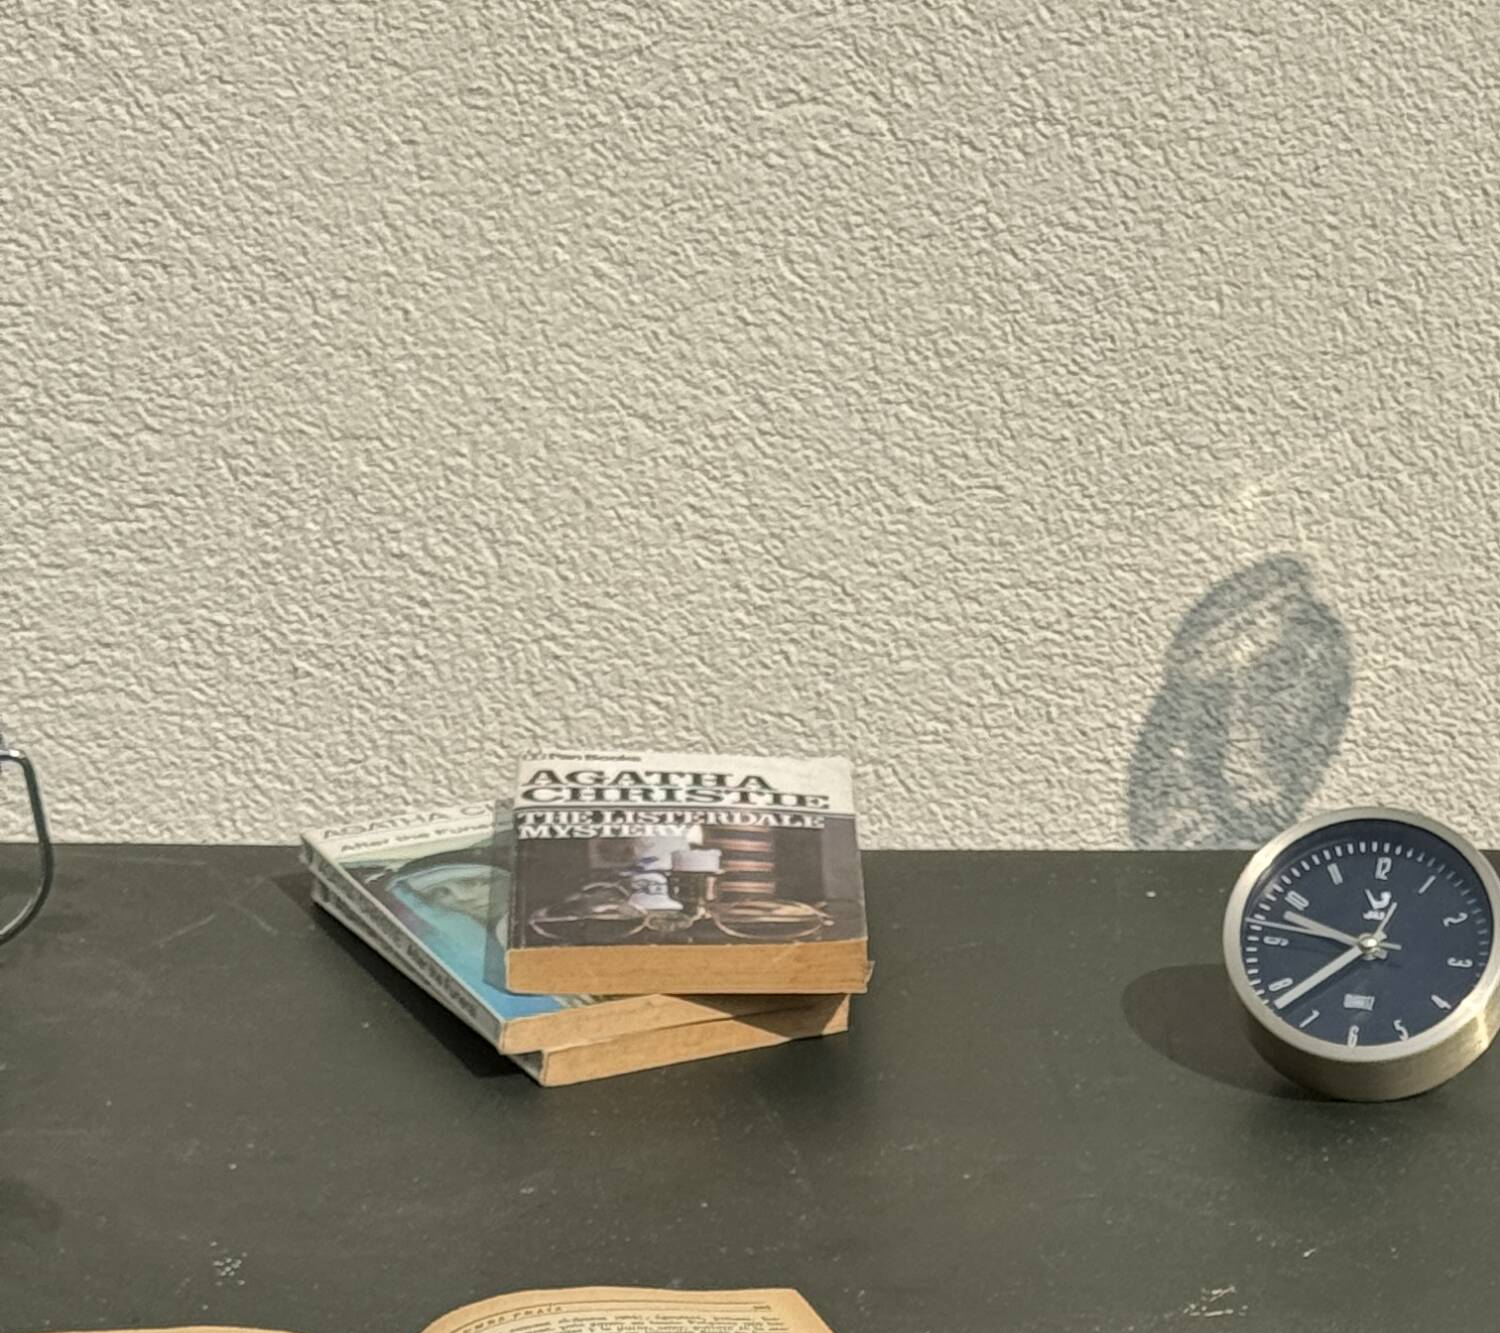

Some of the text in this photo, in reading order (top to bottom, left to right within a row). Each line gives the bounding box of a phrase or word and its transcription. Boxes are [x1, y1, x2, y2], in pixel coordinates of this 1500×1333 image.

[520, 769, 778, 791] AGATHA
[520, 786, 830, 810] CHRISTIE
[518, 810, 825, 828] THE LISTERDALE
[518, 823, 690, 840] MYSTERY
[1375, 857, 1392, 880] 12
[1418, 875, 1436, 894] 1
[1284, 890, 1310, 911] 10
[1443, 912, 1468, 927] 2
[1447, 957, 1473, 969] 3
[1268, 977, 1293, 992] 8
[1431, 994, 1452, 1010] 4
[1393, 1019, 1409, 1041] 5
